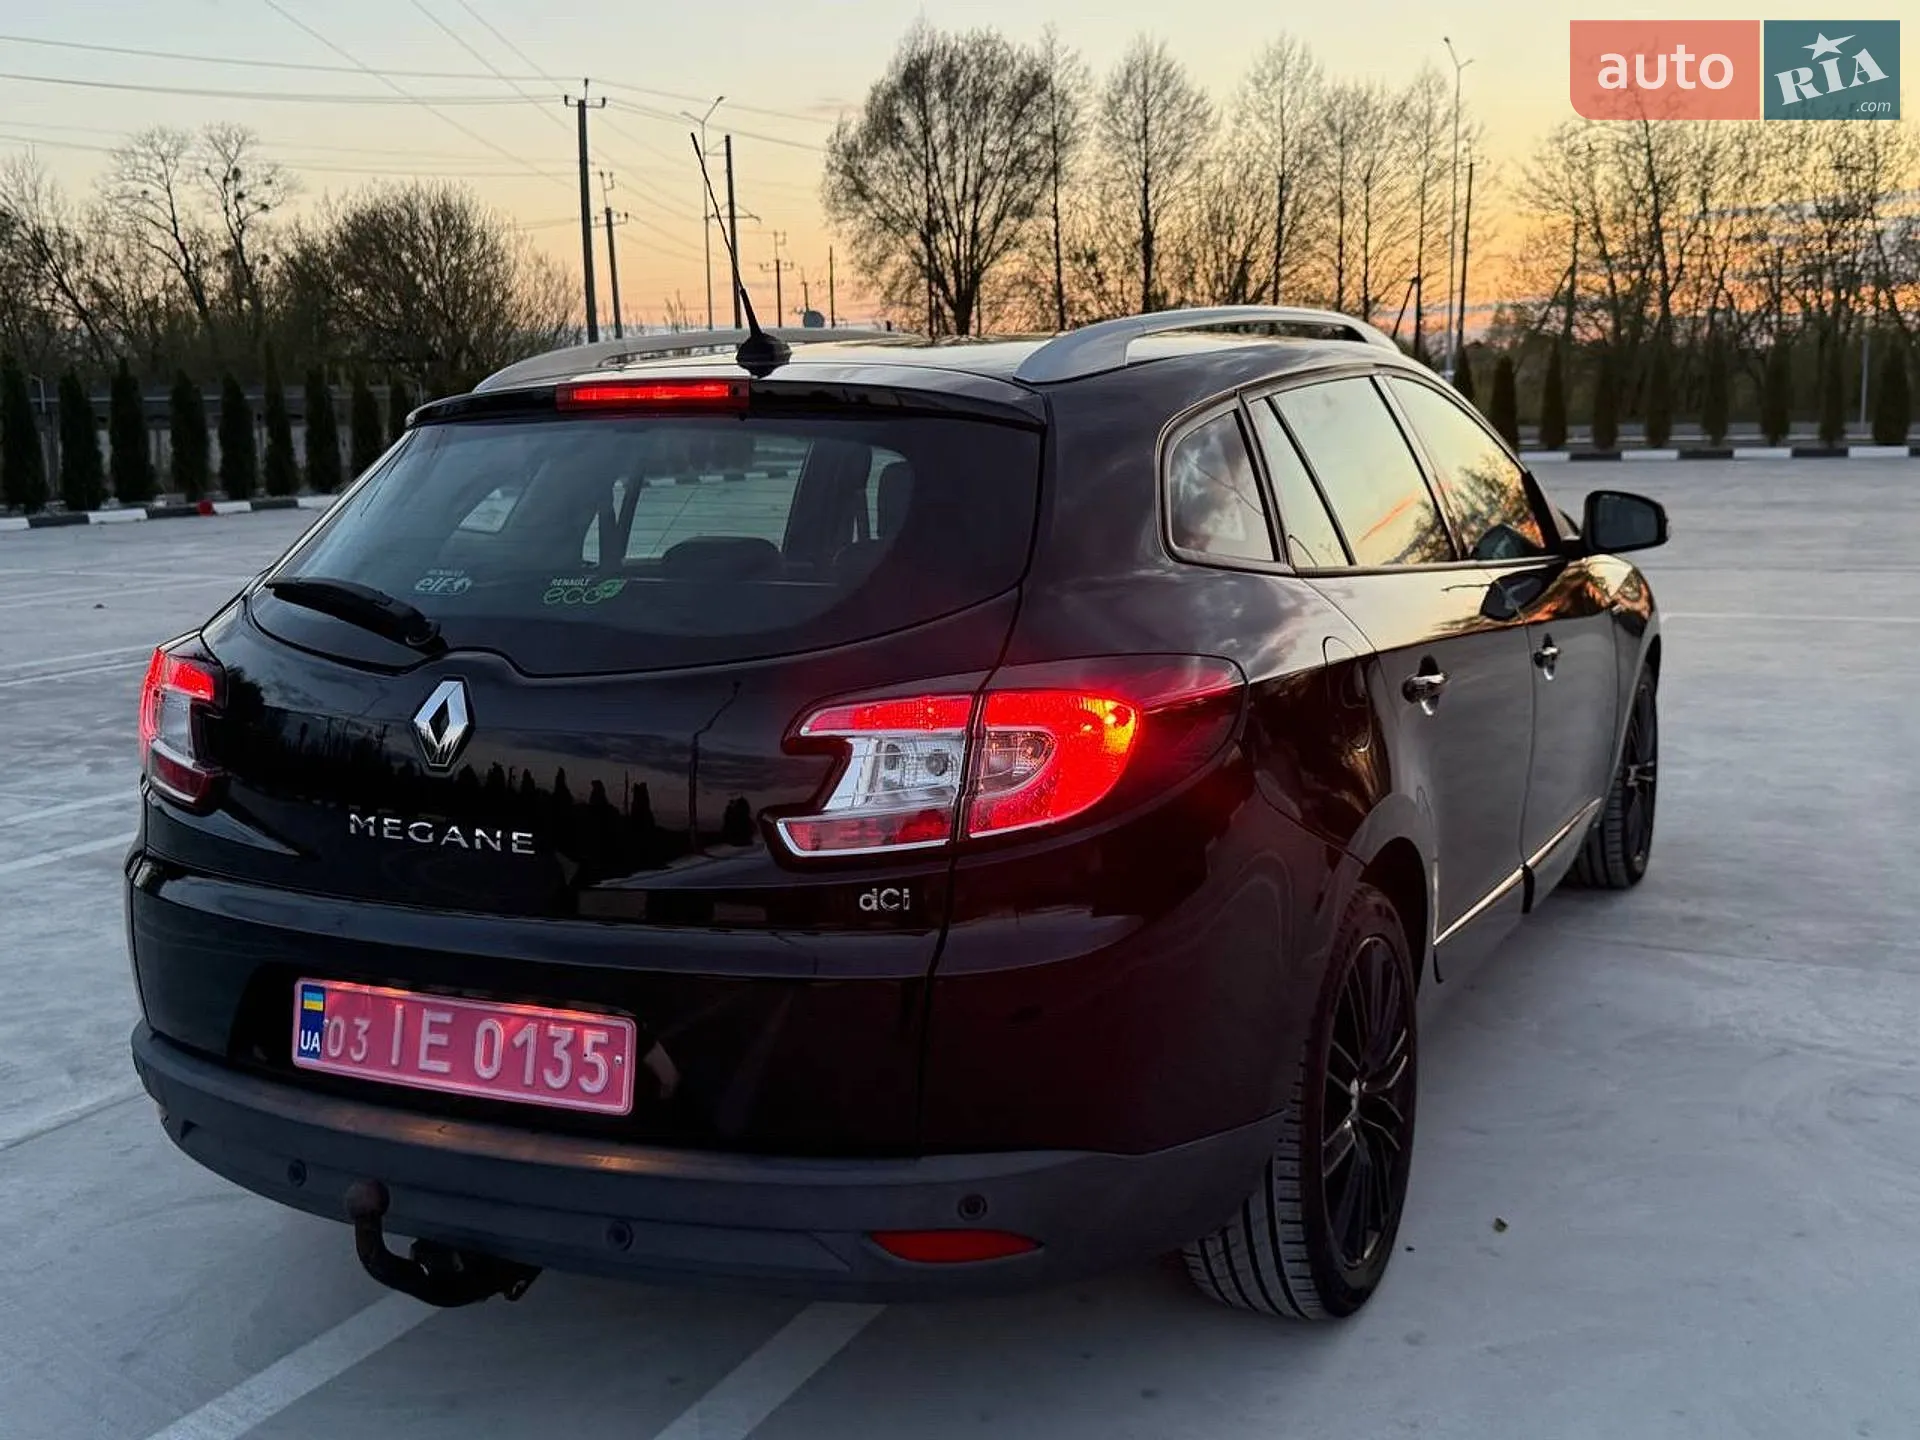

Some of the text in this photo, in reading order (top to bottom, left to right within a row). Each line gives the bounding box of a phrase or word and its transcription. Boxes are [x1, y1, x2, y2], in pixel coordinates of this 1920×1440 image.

[348, 812, 536, 855] MEGANE
[859, 888, 910, 911] dCi
[300, 1030, 321, 1052] UA
[327, 1003, 610, 1095] 03 IE 0135
